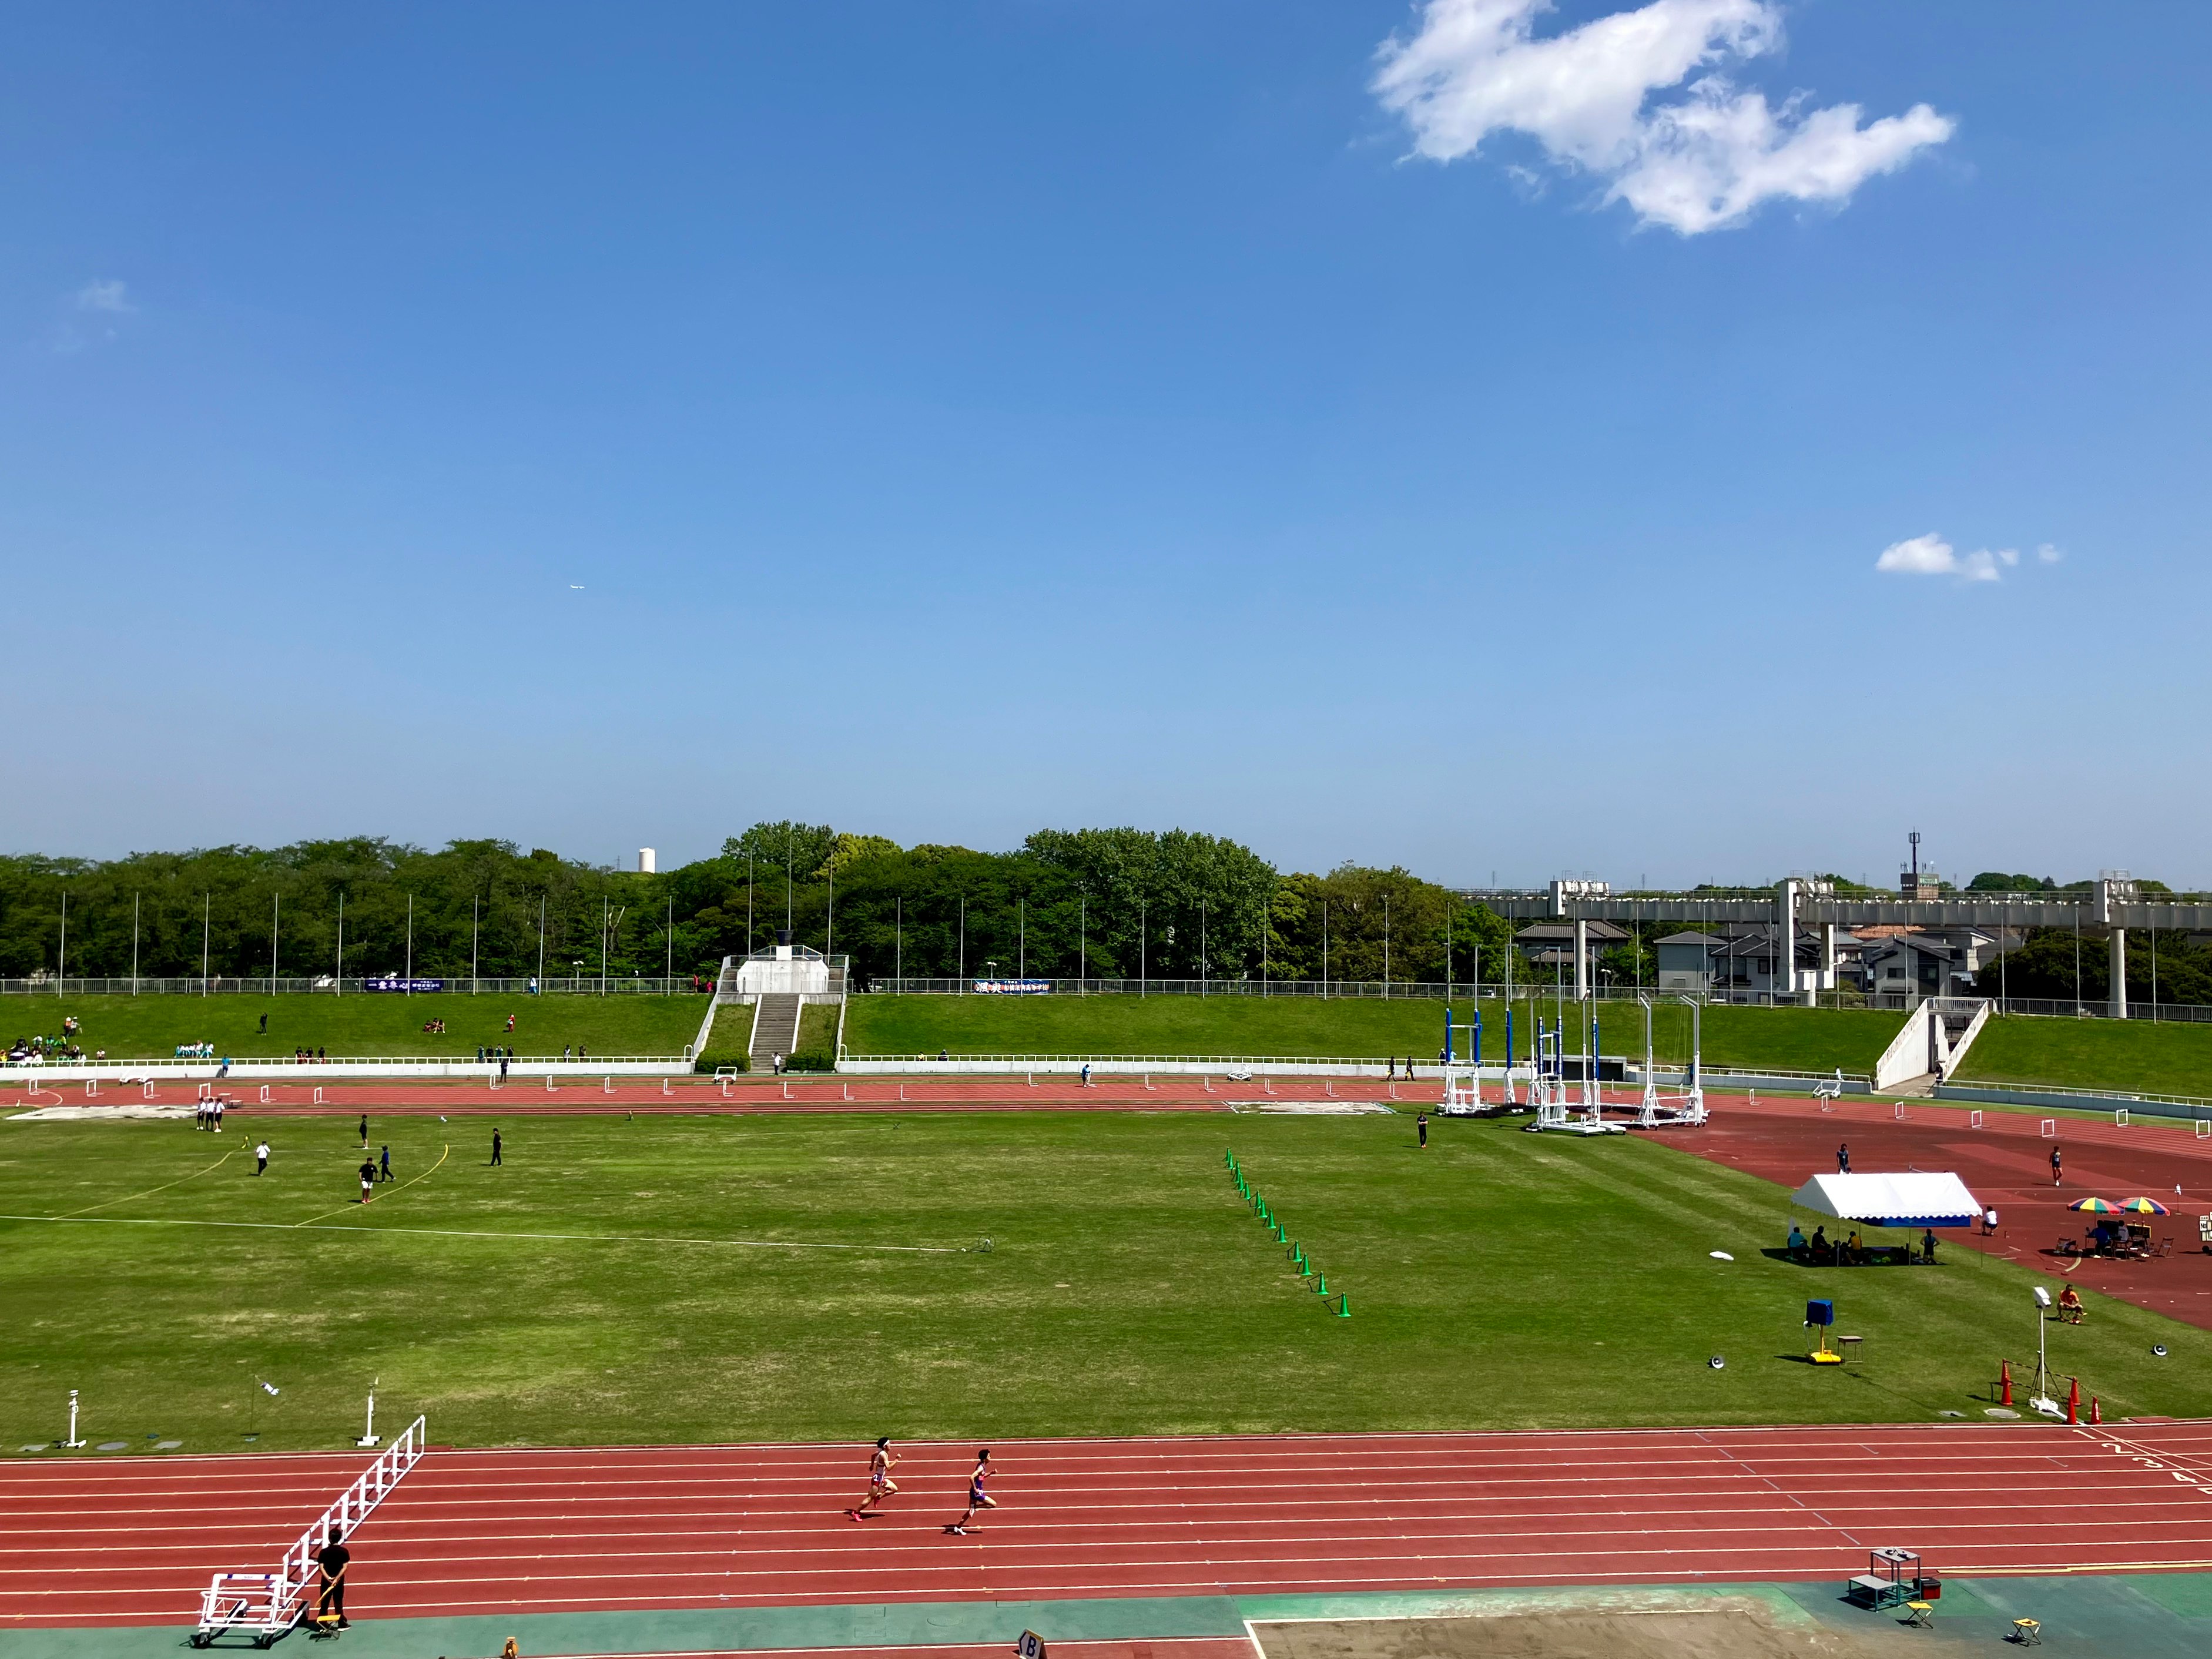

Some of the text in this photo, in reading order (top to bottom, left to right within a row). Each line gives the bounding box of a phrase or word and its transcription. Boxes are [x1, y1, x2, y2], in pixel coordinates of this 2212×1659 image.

[2073, 1429, 2097, 1440] 1
[2101, 1443, 2134, 1454] 2
[2132, 1457, 2164, 1469] 3
[2171, 1472, 2198, 1483] 4
[1026, 1635, 1036, 1657] B
